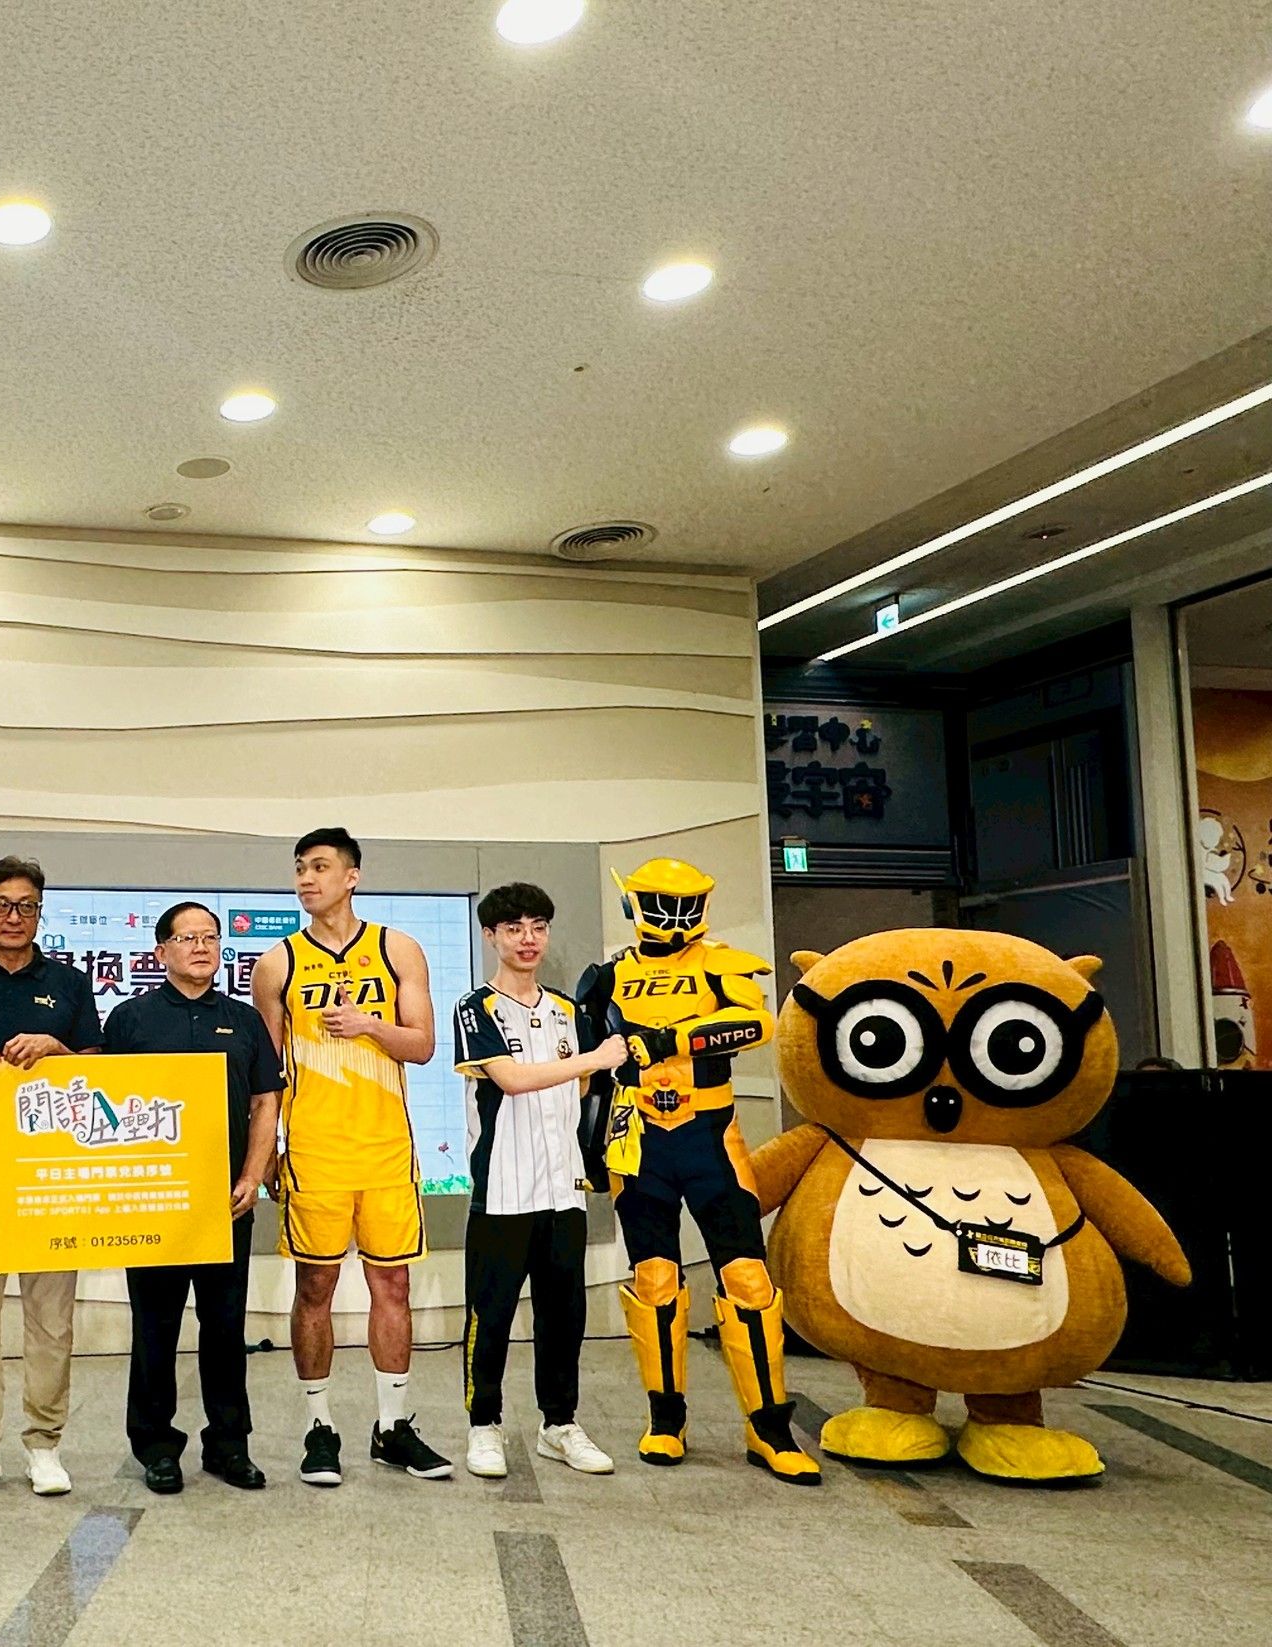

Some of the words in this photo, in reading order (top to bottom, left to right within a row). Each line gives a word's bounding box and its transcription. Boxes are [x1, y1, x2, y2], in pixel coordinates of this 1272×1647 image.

[622, 975, 698, 1000] DEA
[709, 1028, 756, 1046] NTPC
[21, 1082, 46, 1094] 2025
